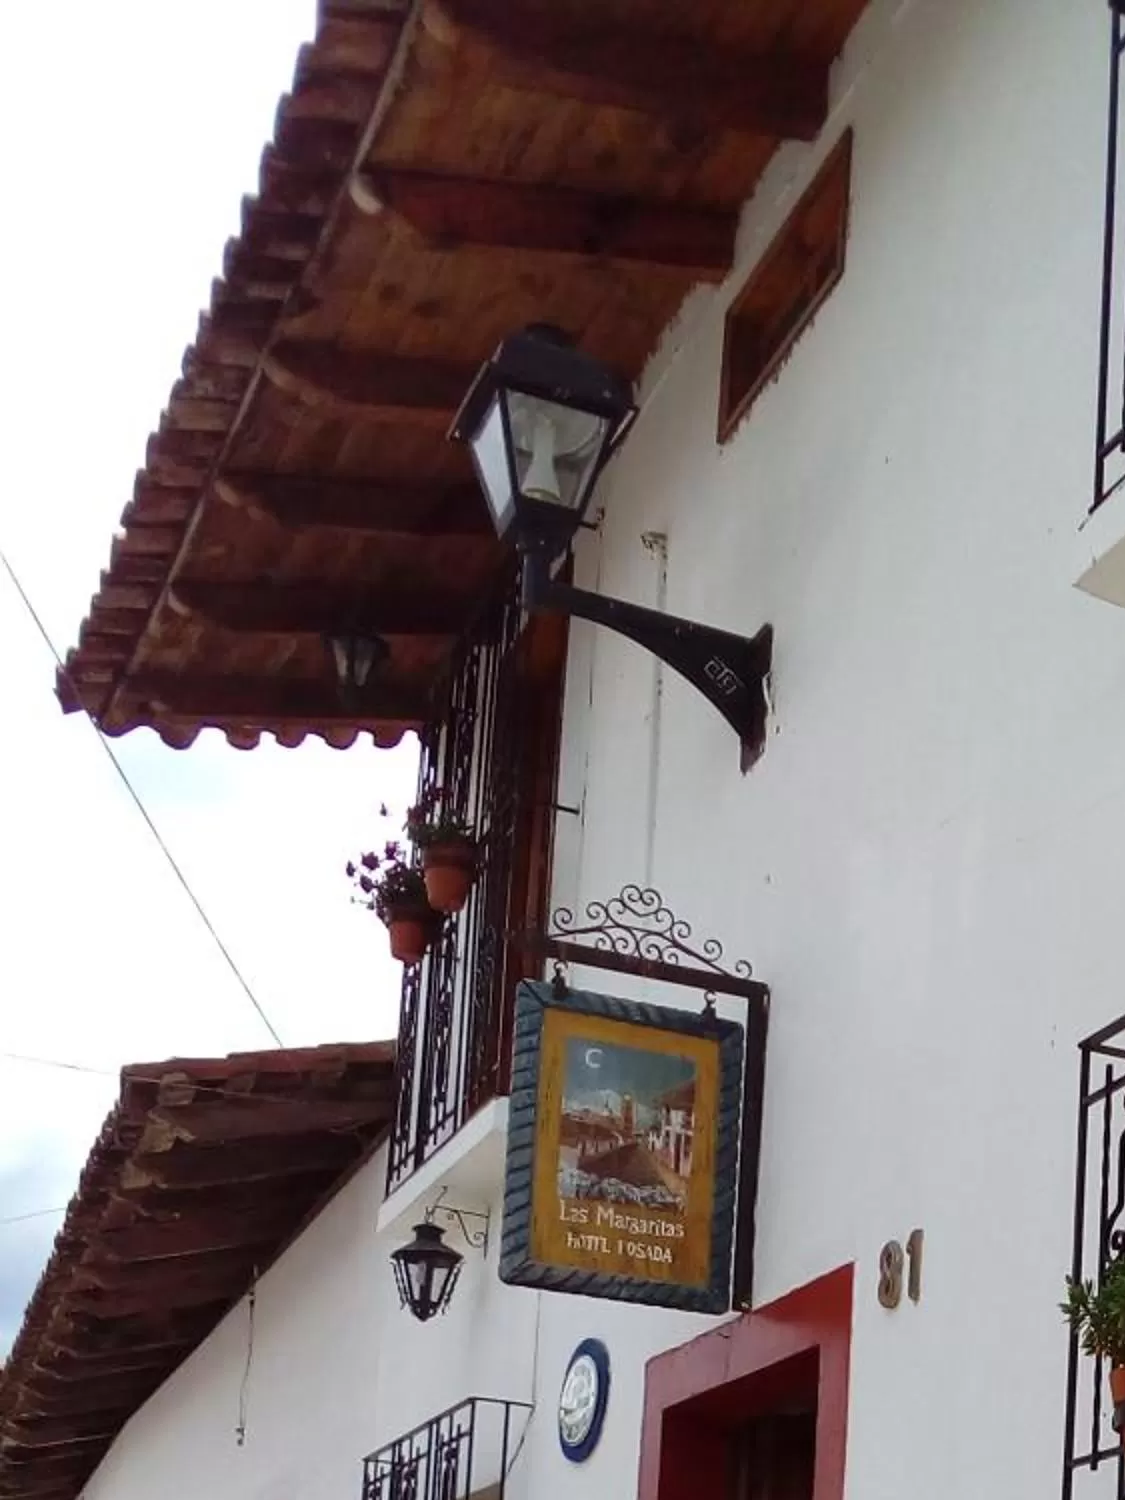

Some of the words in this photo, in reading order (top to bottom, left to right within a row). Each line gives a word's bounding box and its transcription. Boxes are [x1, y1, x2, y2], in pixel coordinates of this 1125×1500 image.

[560, 1200, 588, 1223] Las
[596, 1204, 684, 1237] Margaritas
[567, 1232, 611, 1254] HOTEL
